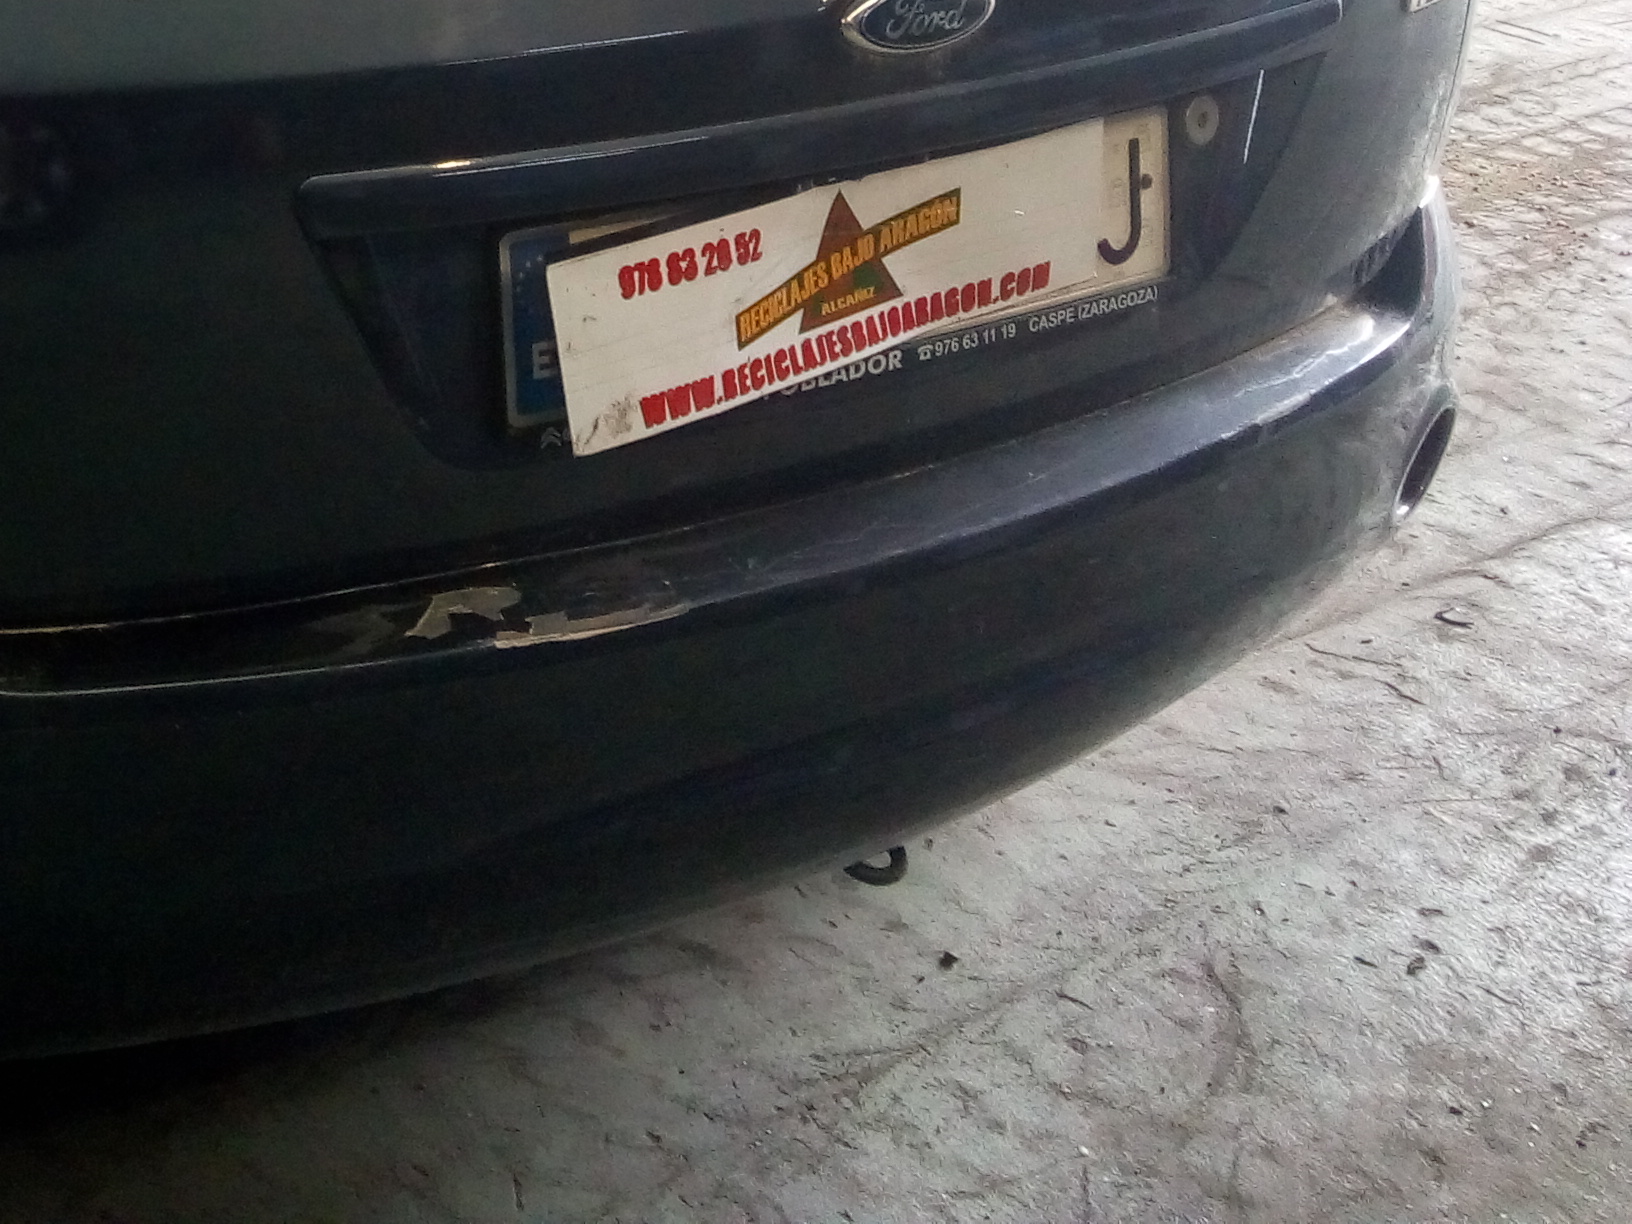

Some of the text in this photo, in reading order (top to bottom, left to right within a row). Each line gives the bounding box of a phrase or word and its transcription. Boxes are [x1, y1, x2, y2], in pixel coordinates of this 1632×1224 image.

[618, 257, 663, 300] 978
[734, 228, 762, 266] 52
[739, 261, 829, 343] RECICLAJES
[830, 233, 875, 281] BAJO
[934, 337, 960, 357] 976
[962, 332, 979, 350] 63
[983, 329, 996, 345] 11
[1001, 323, 1016, 339] 19
[1029, 307, 1076, 332] CASPE
[1078, 285, 1158, 321] (ZARAGOZA)
[531, 341, 559, 380] E
